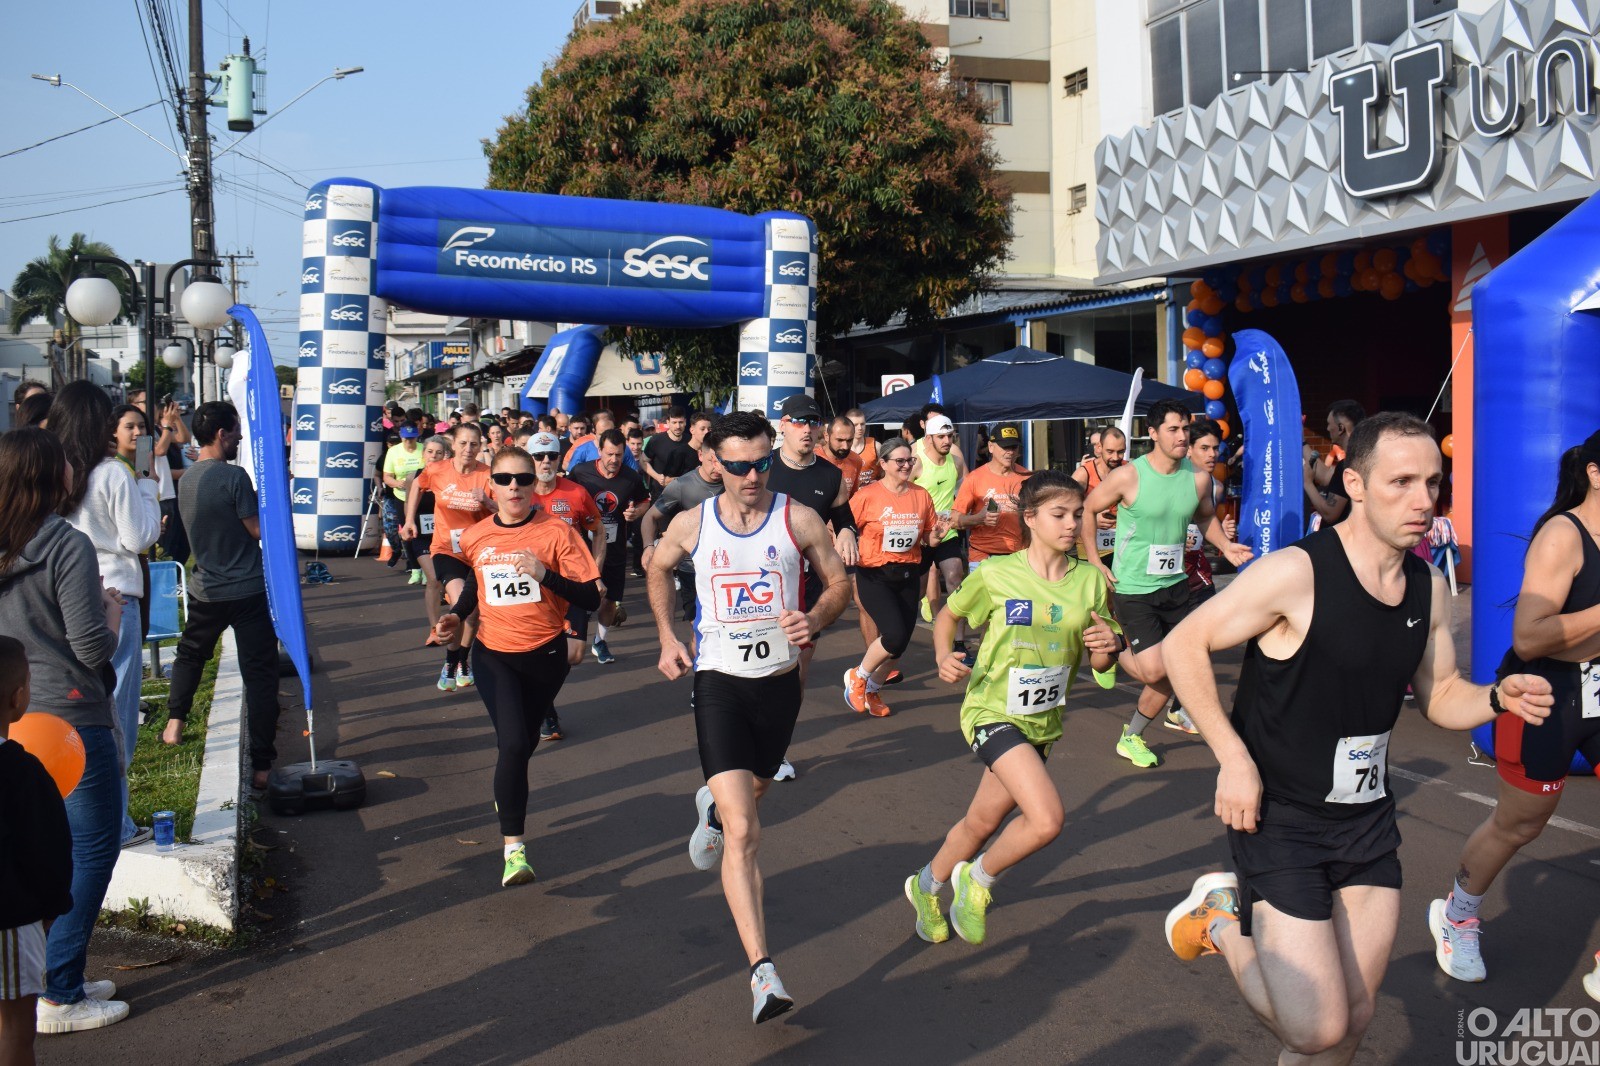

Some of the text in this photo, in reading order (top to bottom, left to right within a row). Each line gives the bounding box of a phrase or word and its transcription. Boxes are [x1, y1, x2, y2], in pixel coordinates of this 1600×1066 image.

[1329, 39, 1452, 198] U
[332, 235, 365, 247] Sesc
[455, 250, 597, 275] Fecomércio RS
[622, 248, 708, 281] Sesc
[779, 264, 806, 277] Sesc
[330, 309, 363, 321] Sesc
[775, 333, 802, 344] Sesc
[741, 367, 762, 377] Sesc
[328, 383, 361, 395] Sesc
[622, 379, 675, 392] unopa
[325, 457, 358, 468] Sesc
[1263, 440, 1272, 494] Sindicatos
[453, 490, 473, 498] RÚSTI
[1261, 509, 1271, 525] RS
[424, 522, 435, 531] 18
[323, 530, 356, 542] Sesc
[889, 537, 913, 548] 192
[1102, 538, 1115, 547] 86
[489, 552, 525, 563] RÚSTI
[1159, 558, 1175, 570] 76
[492, 581, 531, 598] 145
[721, 581, 774, 607] TAG
[726, 605, 772, 616] TARCISO
[729, 631, 753, 640] Sesc
[738, 640, 770, 662] 70
[1019, 676, 1042, 685] Sesc
[1018, 684, 1060, 707] 125
[1348, 749, 1373, 760] Sesc
[1355, 764, 1379, 793] 78
